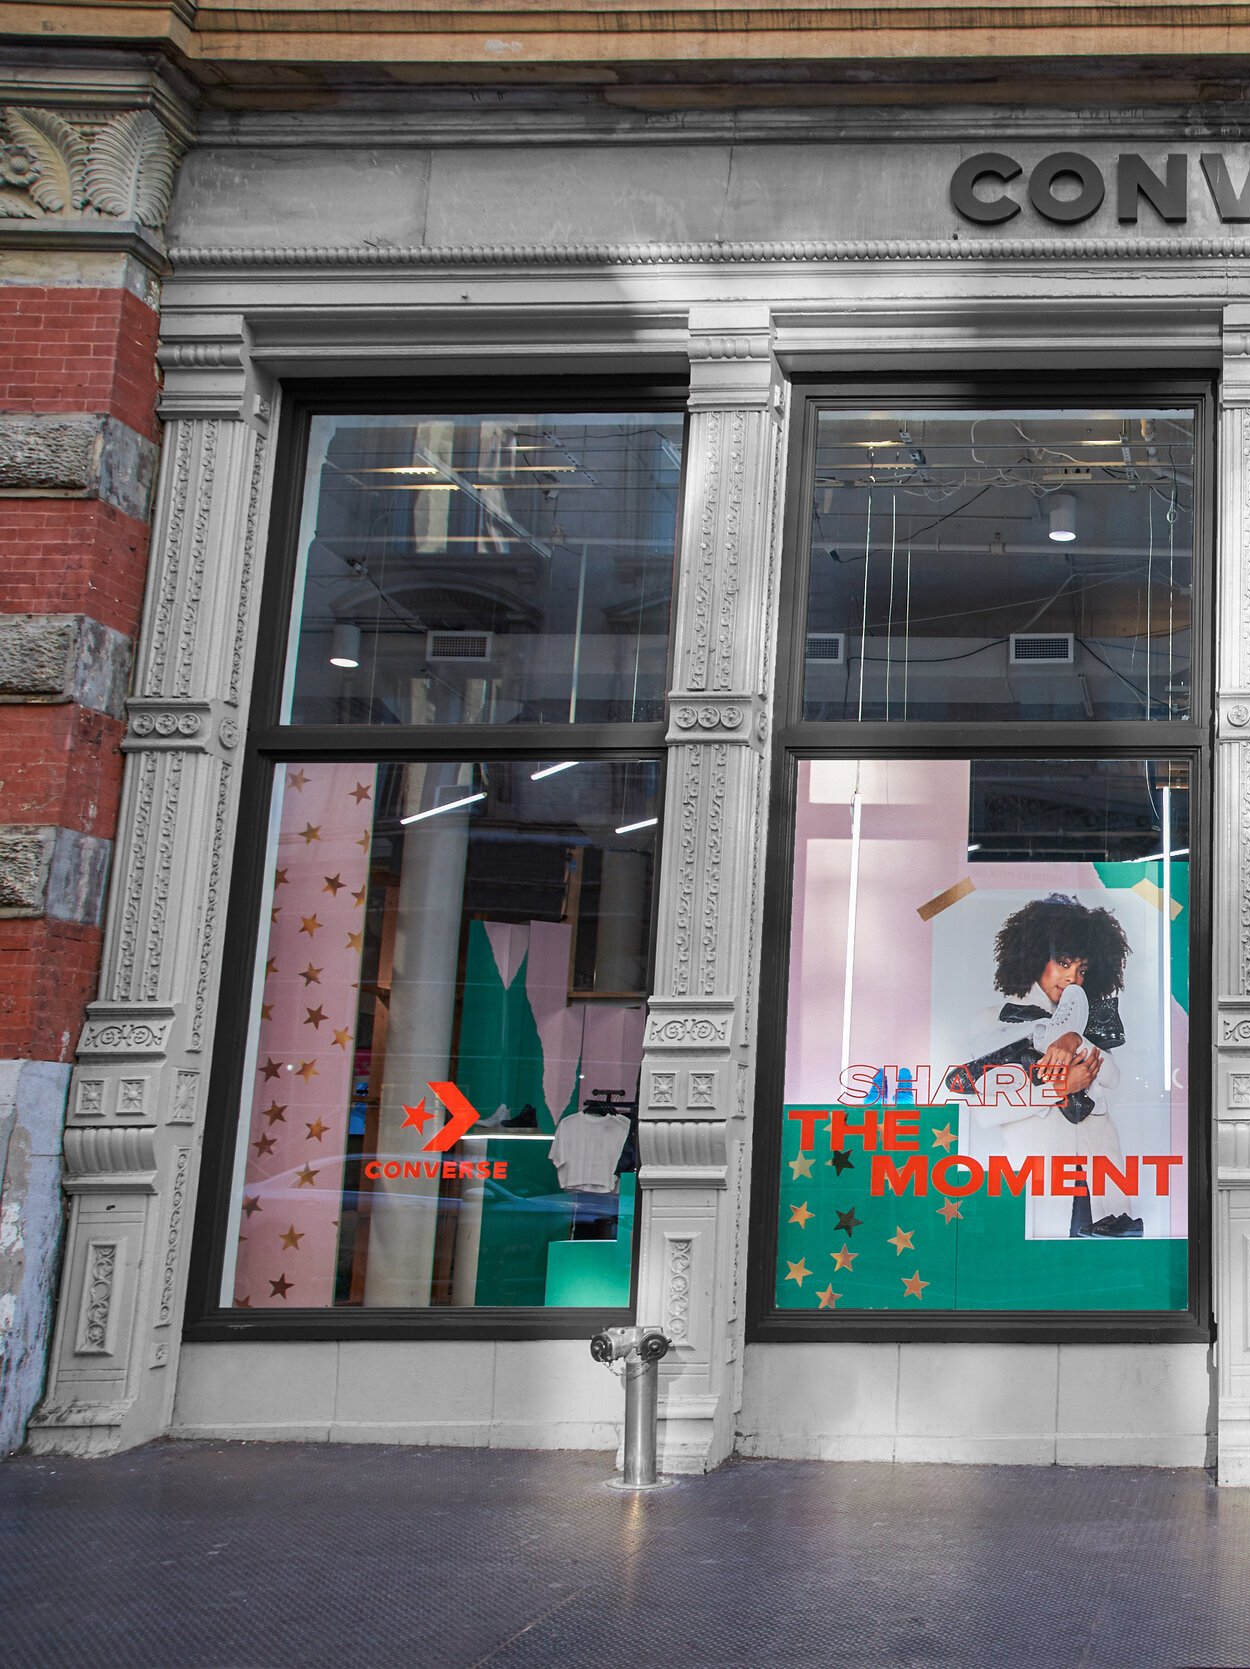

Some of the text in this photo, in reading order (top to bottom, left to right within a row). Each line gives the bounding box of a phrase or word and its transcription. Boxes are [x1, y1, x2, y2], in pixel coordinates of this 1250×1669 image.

[837, 1064, 1070, 1108] SHARE
[788, 1110, 921, 1151] THE
[364, 1160, 508, 1180] CONVERSE
[870, 1155, 1184, 1197] MOMENT
